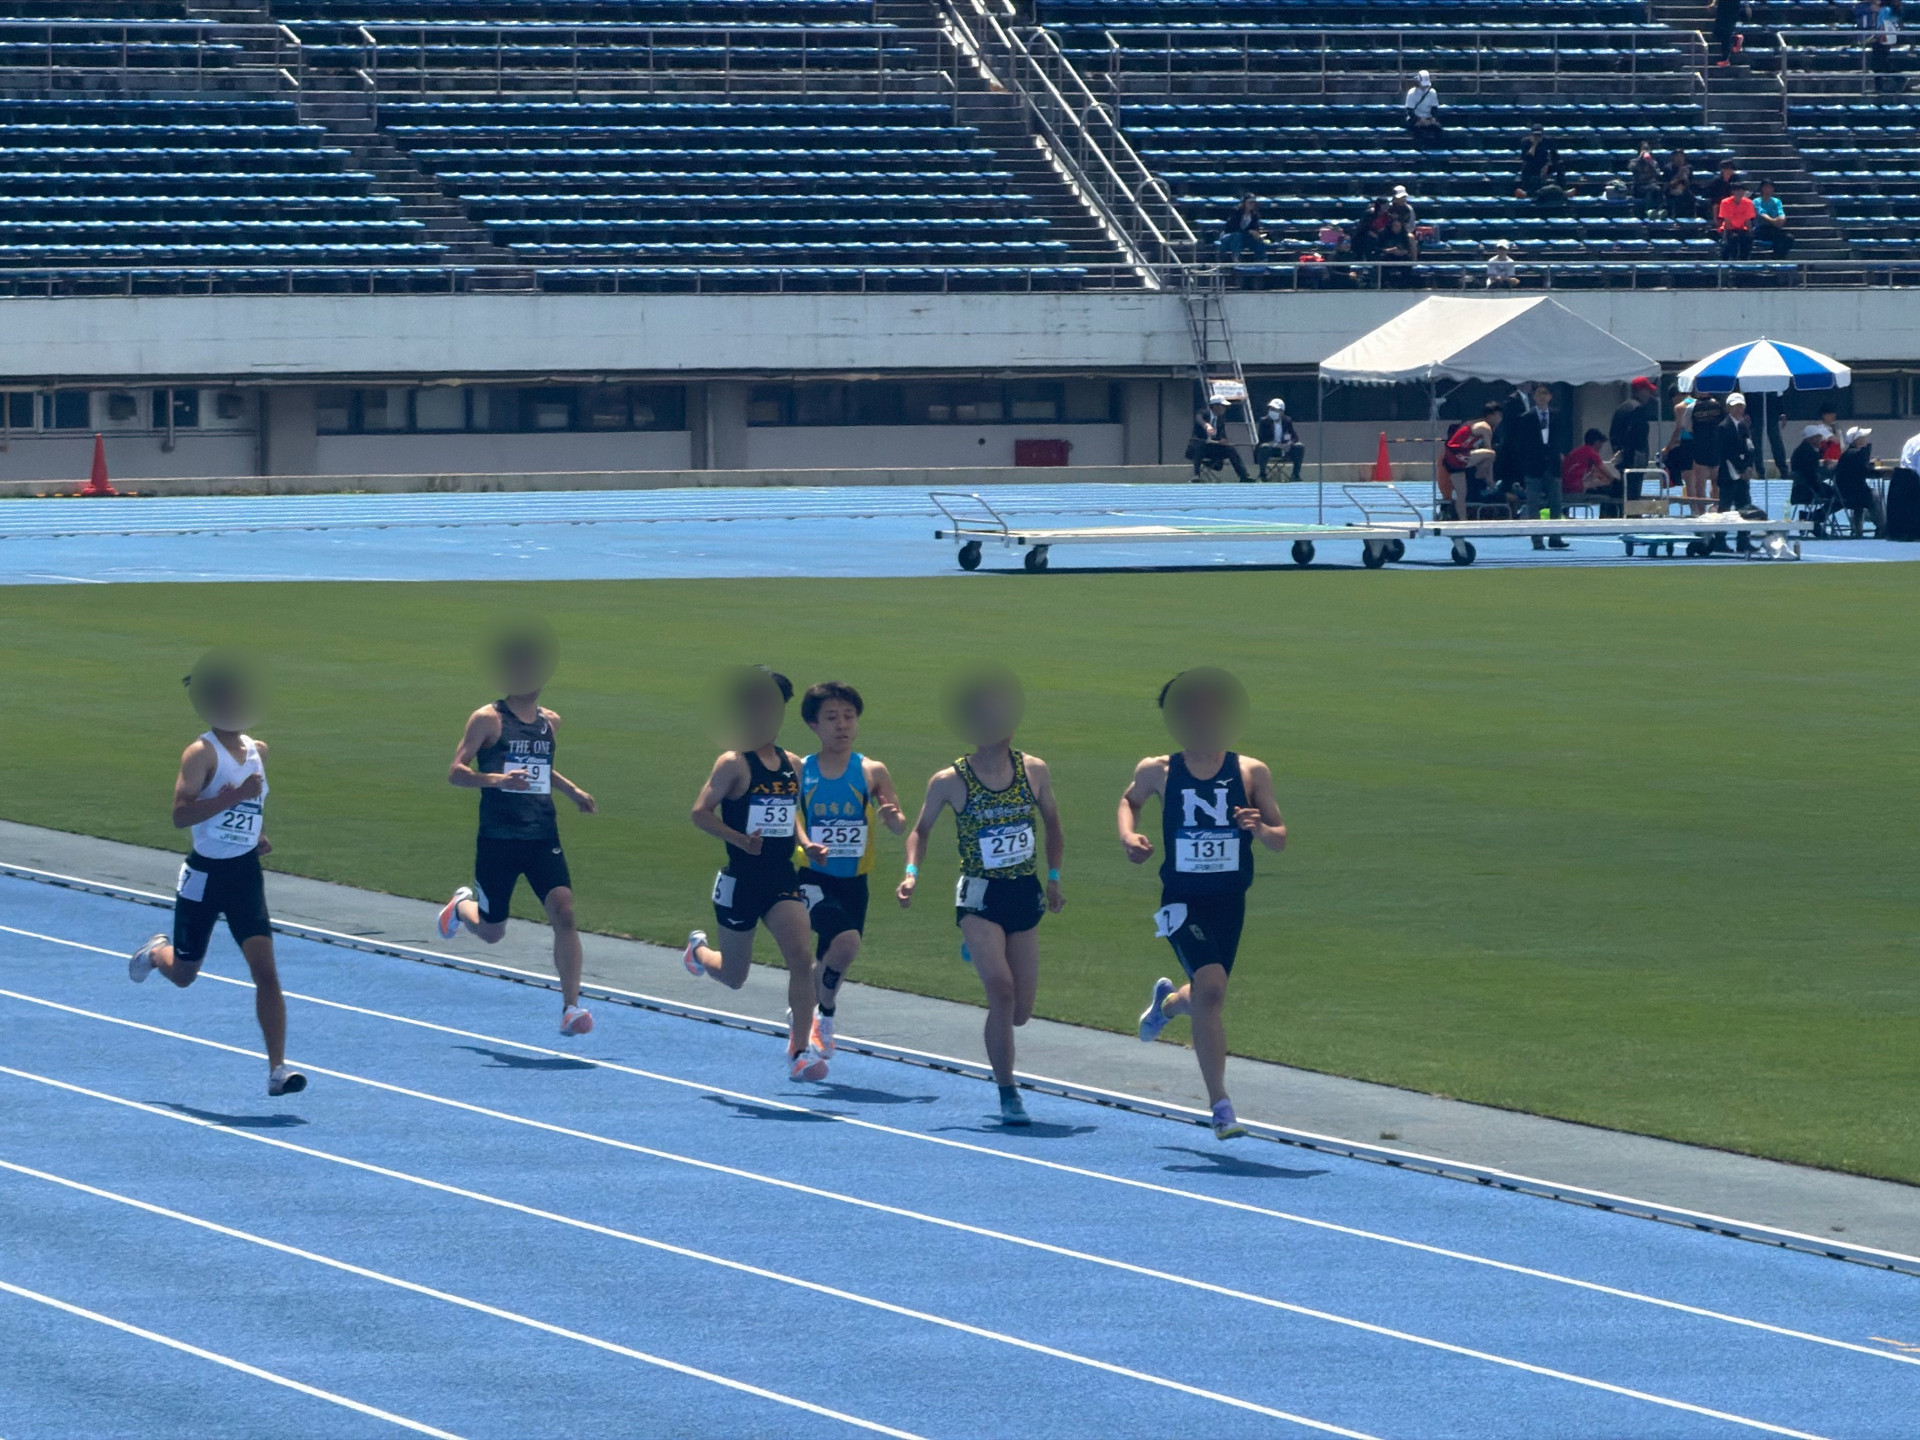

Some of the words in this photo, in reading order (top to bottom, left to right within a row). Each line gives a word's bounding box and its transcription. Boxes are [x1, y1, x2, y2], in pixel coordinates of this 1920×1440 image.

[508, 740, 531, 754] THE
[533, 740, 551, 755] ONE
[764, 807, 788, 823] 53
[1181, 788, 1230, 827] N
[222, 811, 254, 831] 221
[822, 827, 861, 843] 252
[991, 832, 1029, 855] 279
[1190, 840, 1226, 858] 131
[1163, 910, 1174, 933] 2
